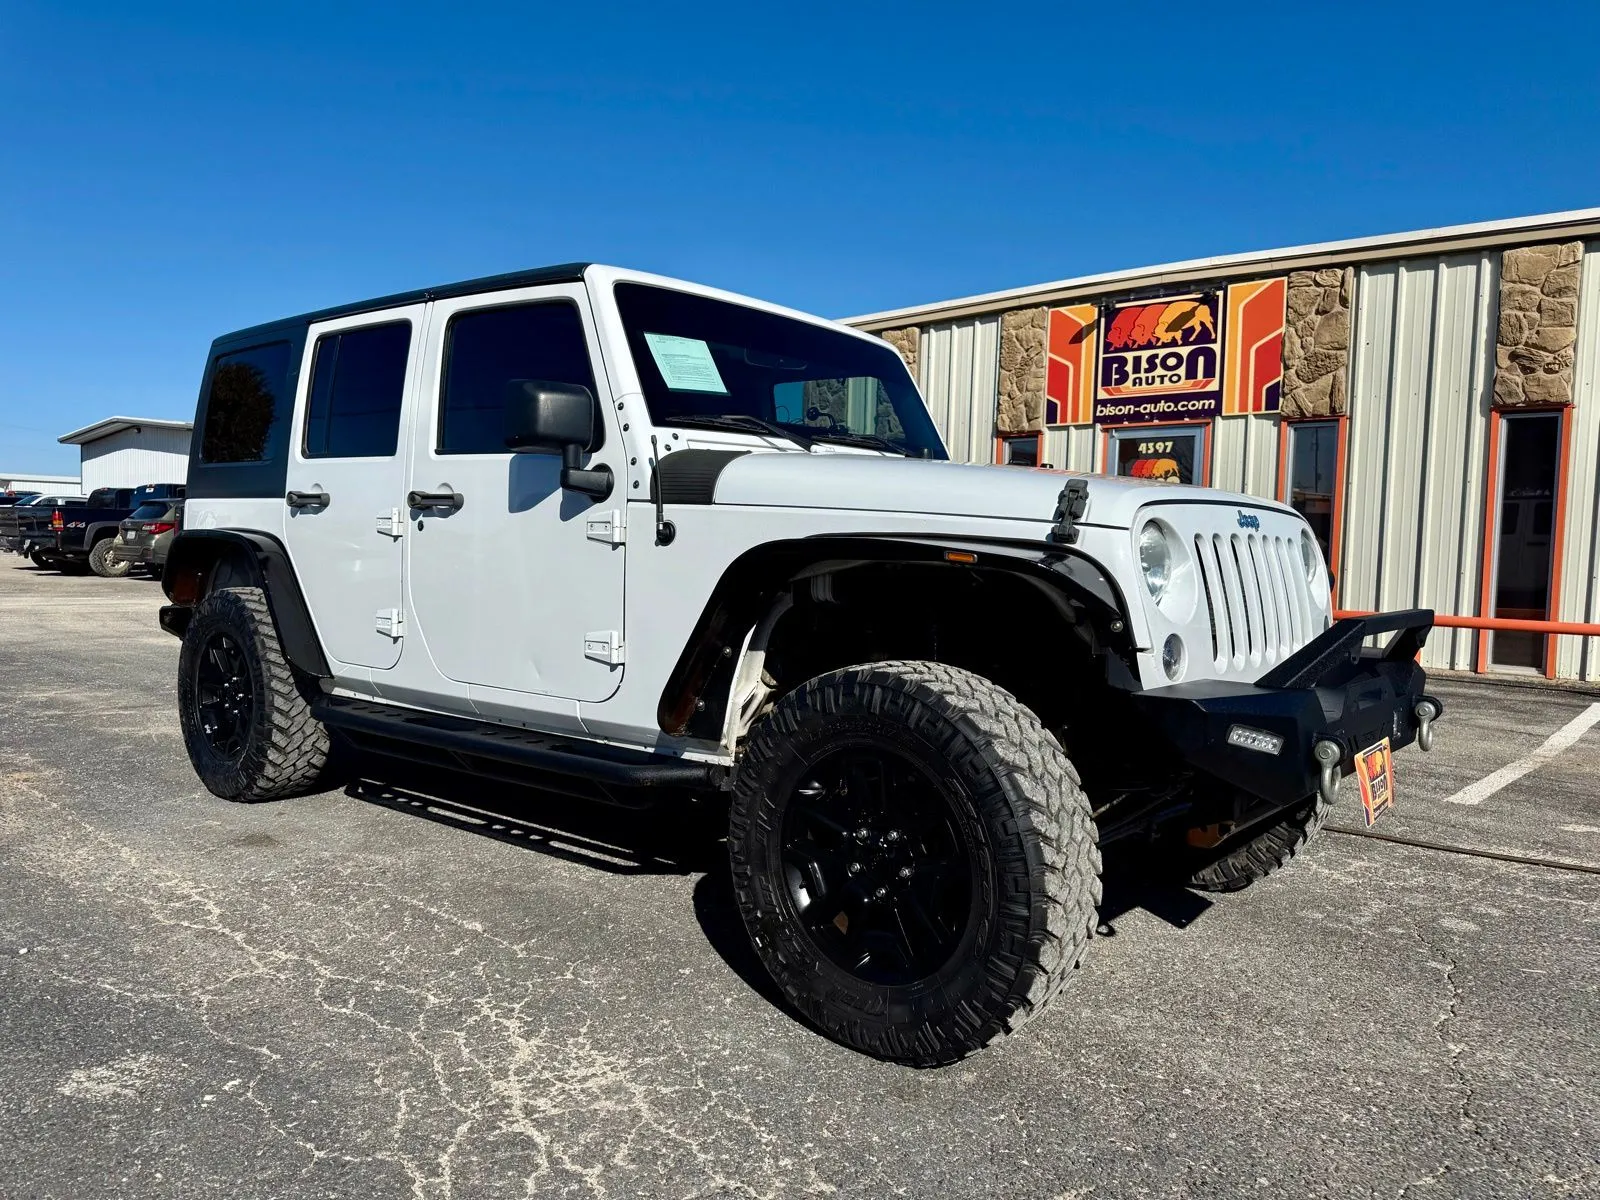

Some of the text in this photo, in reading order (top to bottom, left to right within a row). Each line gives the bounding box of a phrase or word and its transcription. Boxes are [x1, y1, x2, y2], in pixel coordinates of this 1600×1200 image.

[1132, 373, 1182, 387] AUTO
[1096, 399, 1215, 416] bison-auto.com
[1237, 510, 1260, 532] Jeep
